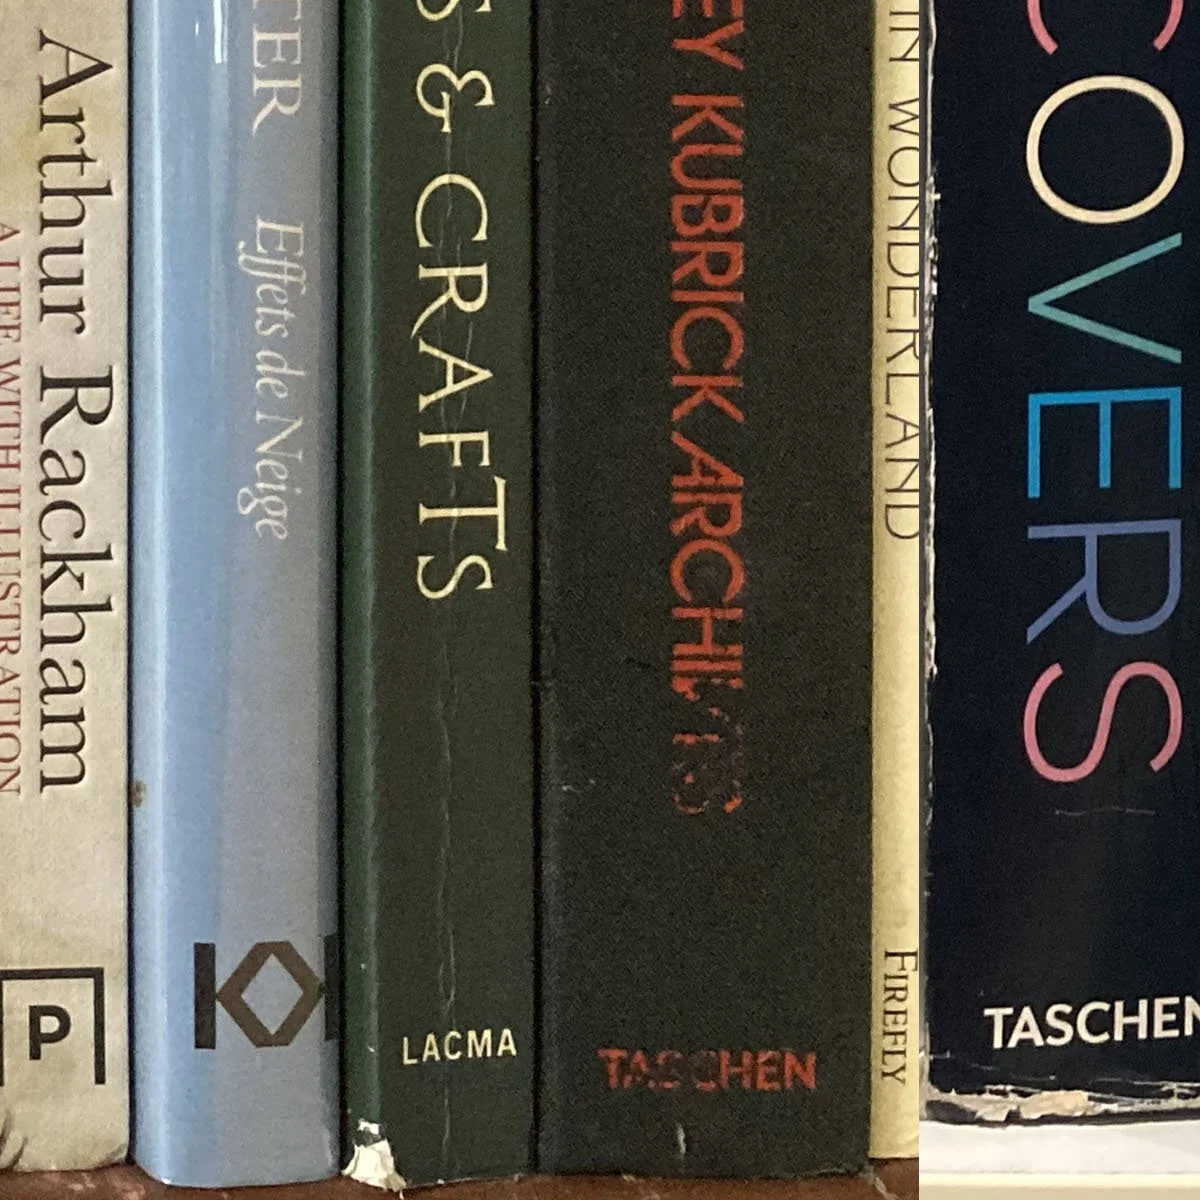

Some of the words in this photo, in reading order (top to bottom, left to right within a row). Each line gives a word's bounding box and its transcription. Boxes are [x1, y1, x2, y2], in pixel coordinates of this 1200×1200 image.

[888, 11, 919, 63] IN
[415, 63, 495, 134] &
[38, 29, 114, 334] Arthur
[236, 217, 304, 338] Effets
[670, 94, 744, 423] KUBRICK
[884, 98, 919, 540] WONDERLAND
[255, 349, 306, 398] de
[410, 173, 508, 600] CRAFTS
[236, 411, 303, 541] Neige
[38, 365, 115, 794] Rackham
[28, 1005, 72, 1061] P
[402, 1028, 518, 1065] LACMA
[597, 1048, 817, 1091] TASCHEN
